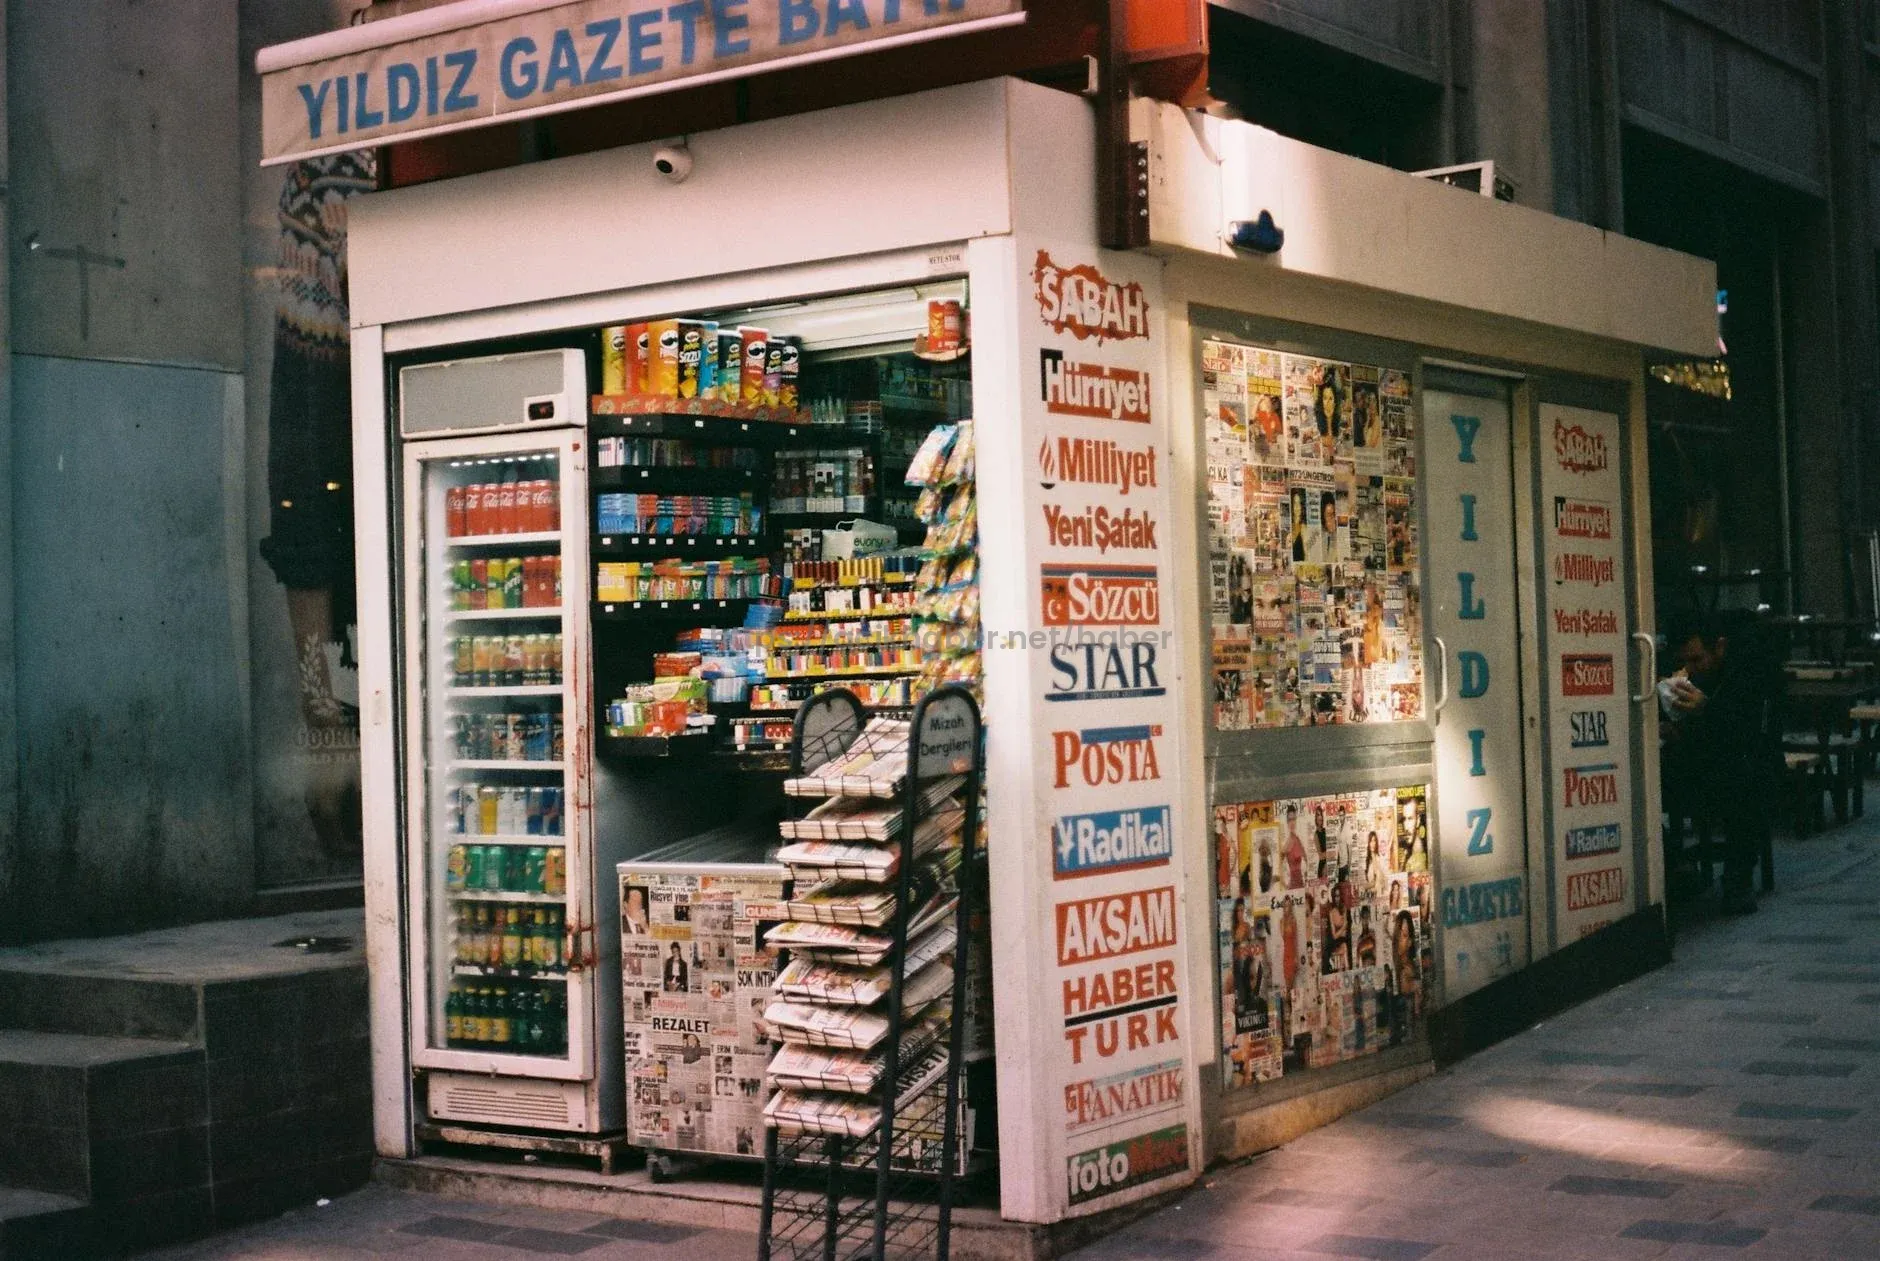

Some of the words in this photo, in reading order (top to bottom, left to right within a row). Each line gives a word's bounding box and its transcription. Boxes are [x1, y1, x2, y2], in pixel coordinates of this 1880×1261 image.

[297, 49, 479, 140] YILDIZ
[499, 0, 751, 100] GAZETE
[1038, 267, 1146, 335] SABAH
[1044, 359, 1150, 420] Hürriyet
[1058, 437, 1157, 495] Milliyet
[1556, 426, 1607, 469] SABAH
[1563, 553, 1615, 588] Milliyet
[1451, 414, 1493, 857] YILDIZ
[1050, 641, 1160, 692] STAR
[929, 715, 965, 732] Mizah
[1570, 710, 1608, 741] STAR
[1052, 729, 1161, 789] POSTA
[1563, 767, 1618, 808] POSTA
[1077, 805, 1170, 858] Radikal
[1576, 823, 1621, 853] Radikal
[1063, 960, 1177, 1016] HABER
[652, 1017, 710, 1034] REZALET
